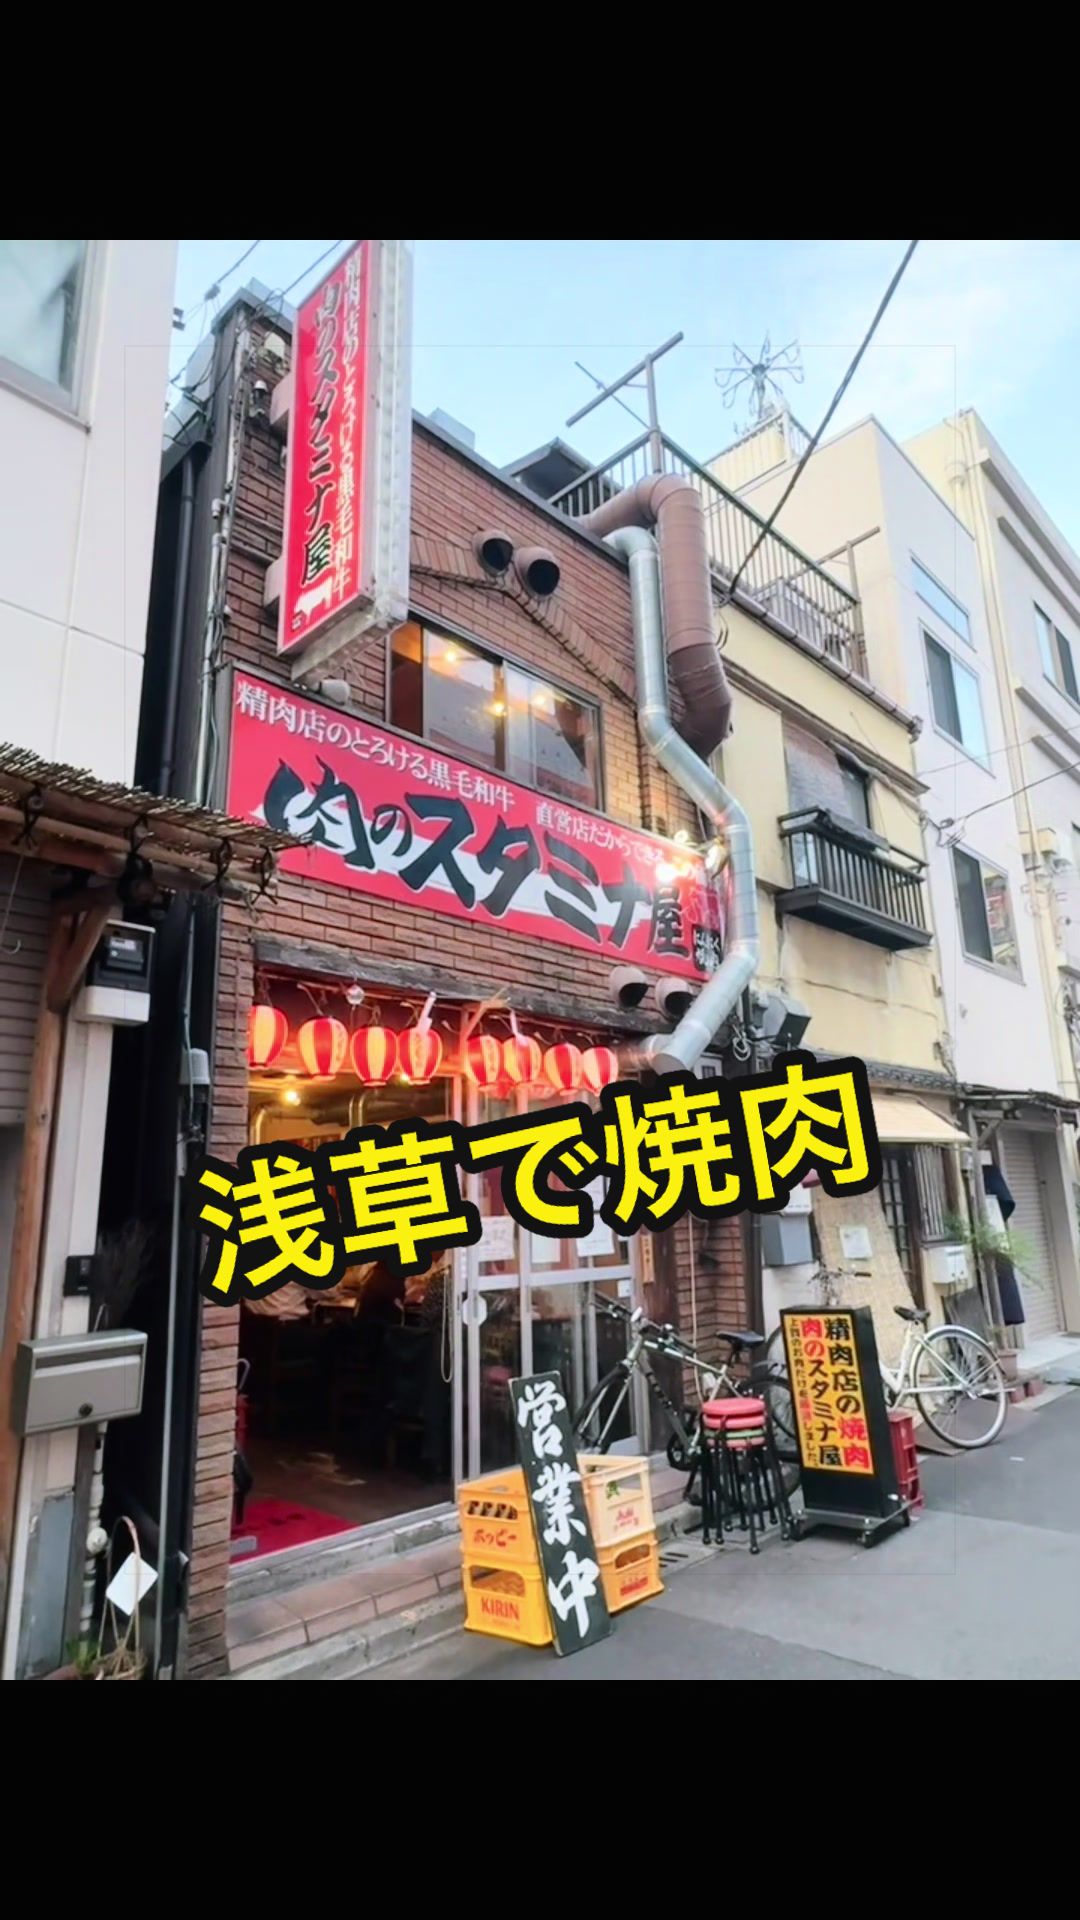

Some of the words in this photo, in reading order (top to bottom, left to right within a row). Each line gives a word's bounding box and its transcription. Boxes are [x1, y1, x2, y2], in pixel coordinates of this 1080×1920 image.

[301, 282, 341, 587] 肉のスタミナ屋
[236, 681, 515, 812] 精肉店のとろける黒毛和牛
[263, 754, 691, 960] 肉のスタミナ屋
[801, 1317, 842, 1467] 肉のスタミナ屋
[825, 1317, 870, 1469] 精肉店の焼肉
[474, 1528, 517, 1547] ホッピー
[518, 1380, 600, 1638] 営業中
[481, 1597, 519, 1621] KIRIN
